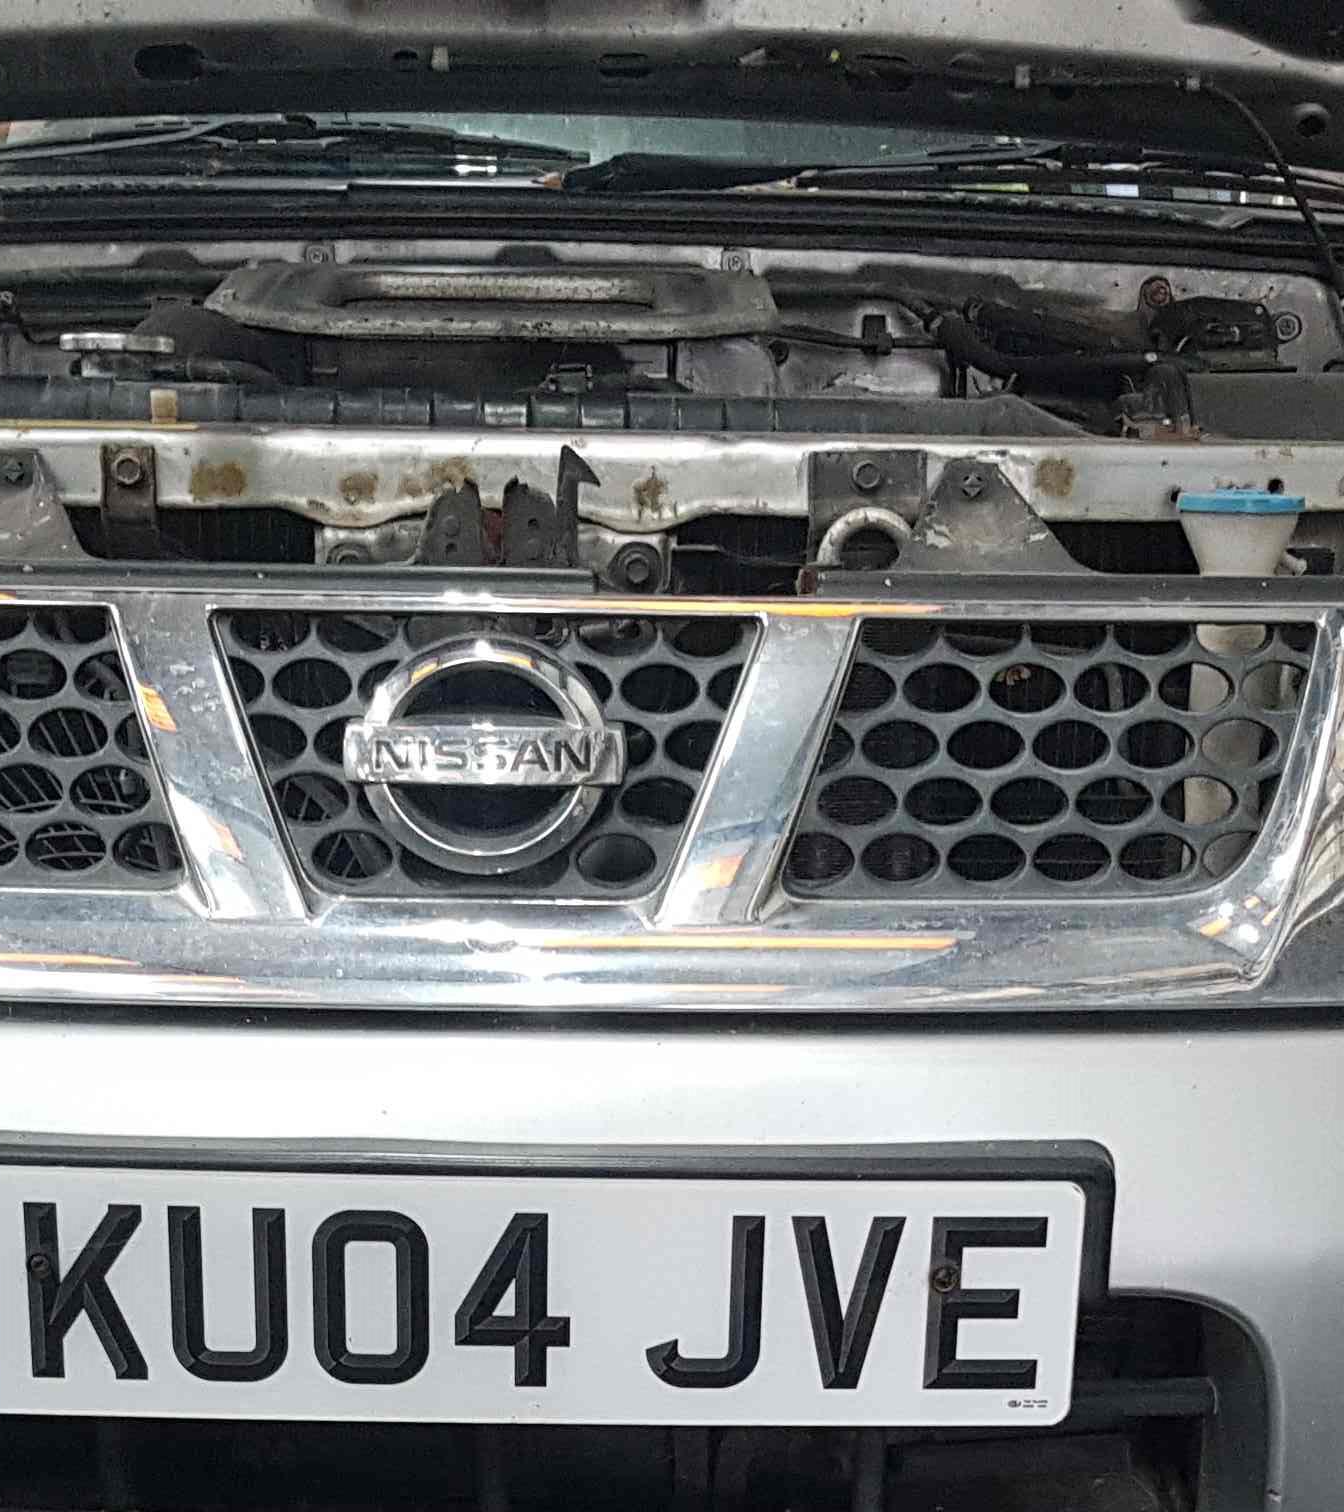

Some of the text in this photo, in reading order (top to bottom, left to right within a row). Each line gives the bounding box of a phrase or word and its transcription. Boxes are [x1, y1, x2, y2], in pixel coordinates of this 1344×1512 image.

[370, 735, 595, 775] NISSAN
[20, 1200, 1047, 1390] KU04 JVE
